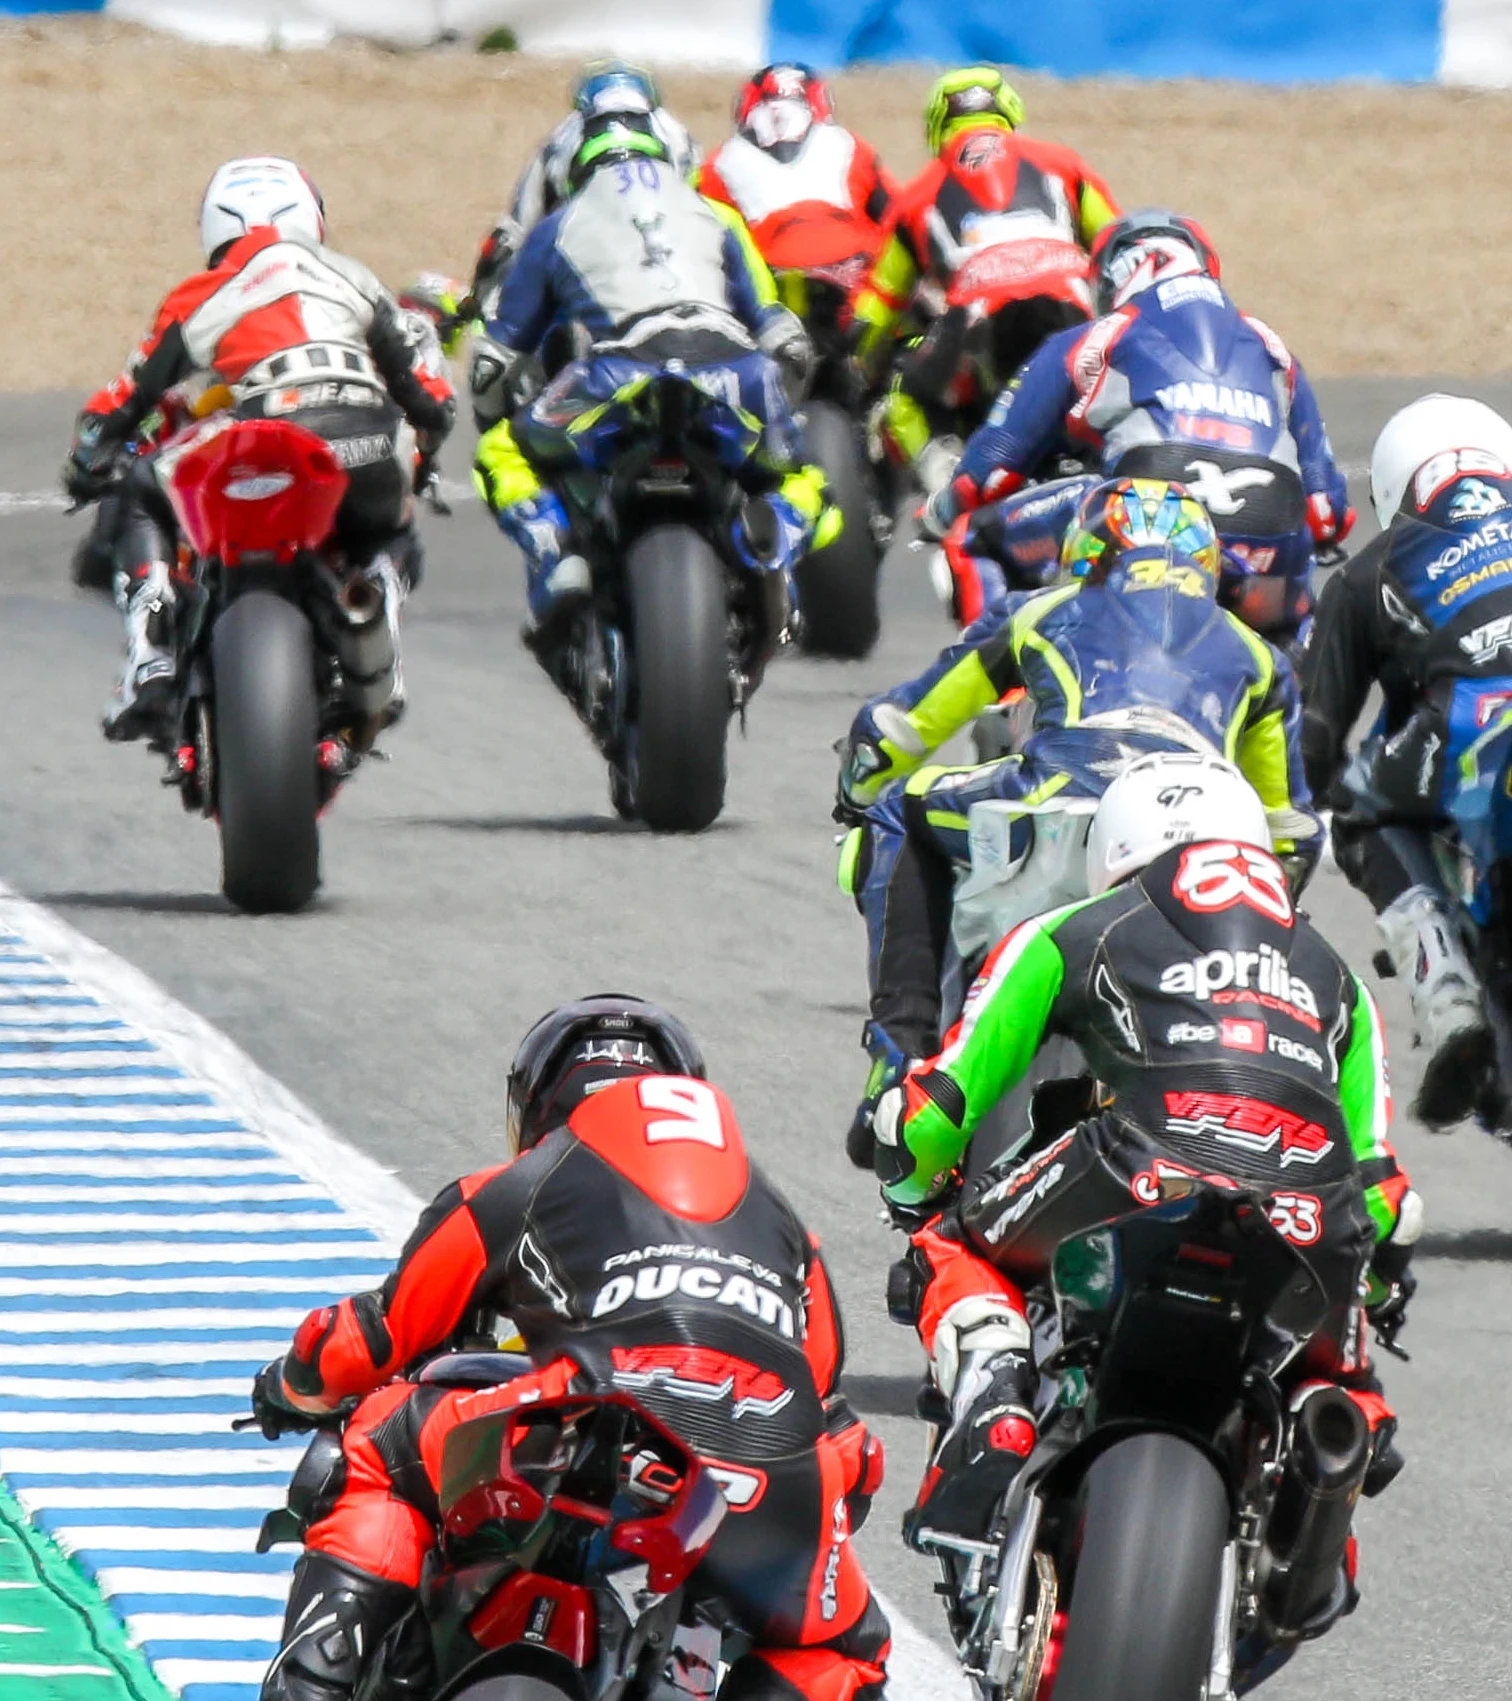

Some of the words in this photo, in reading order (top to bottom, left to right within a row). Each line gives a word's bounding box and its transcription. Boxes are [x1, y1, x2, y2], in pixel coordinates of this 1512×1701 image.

[613, 157, 660, 194] 30
[1154, 381, 1272, 428] YAMAHA
[1176, 841, 1294, 926] 53
[1159, 943, 1320, 1019] aprilia
[591, 1264, 795, 1339] DUCATI
